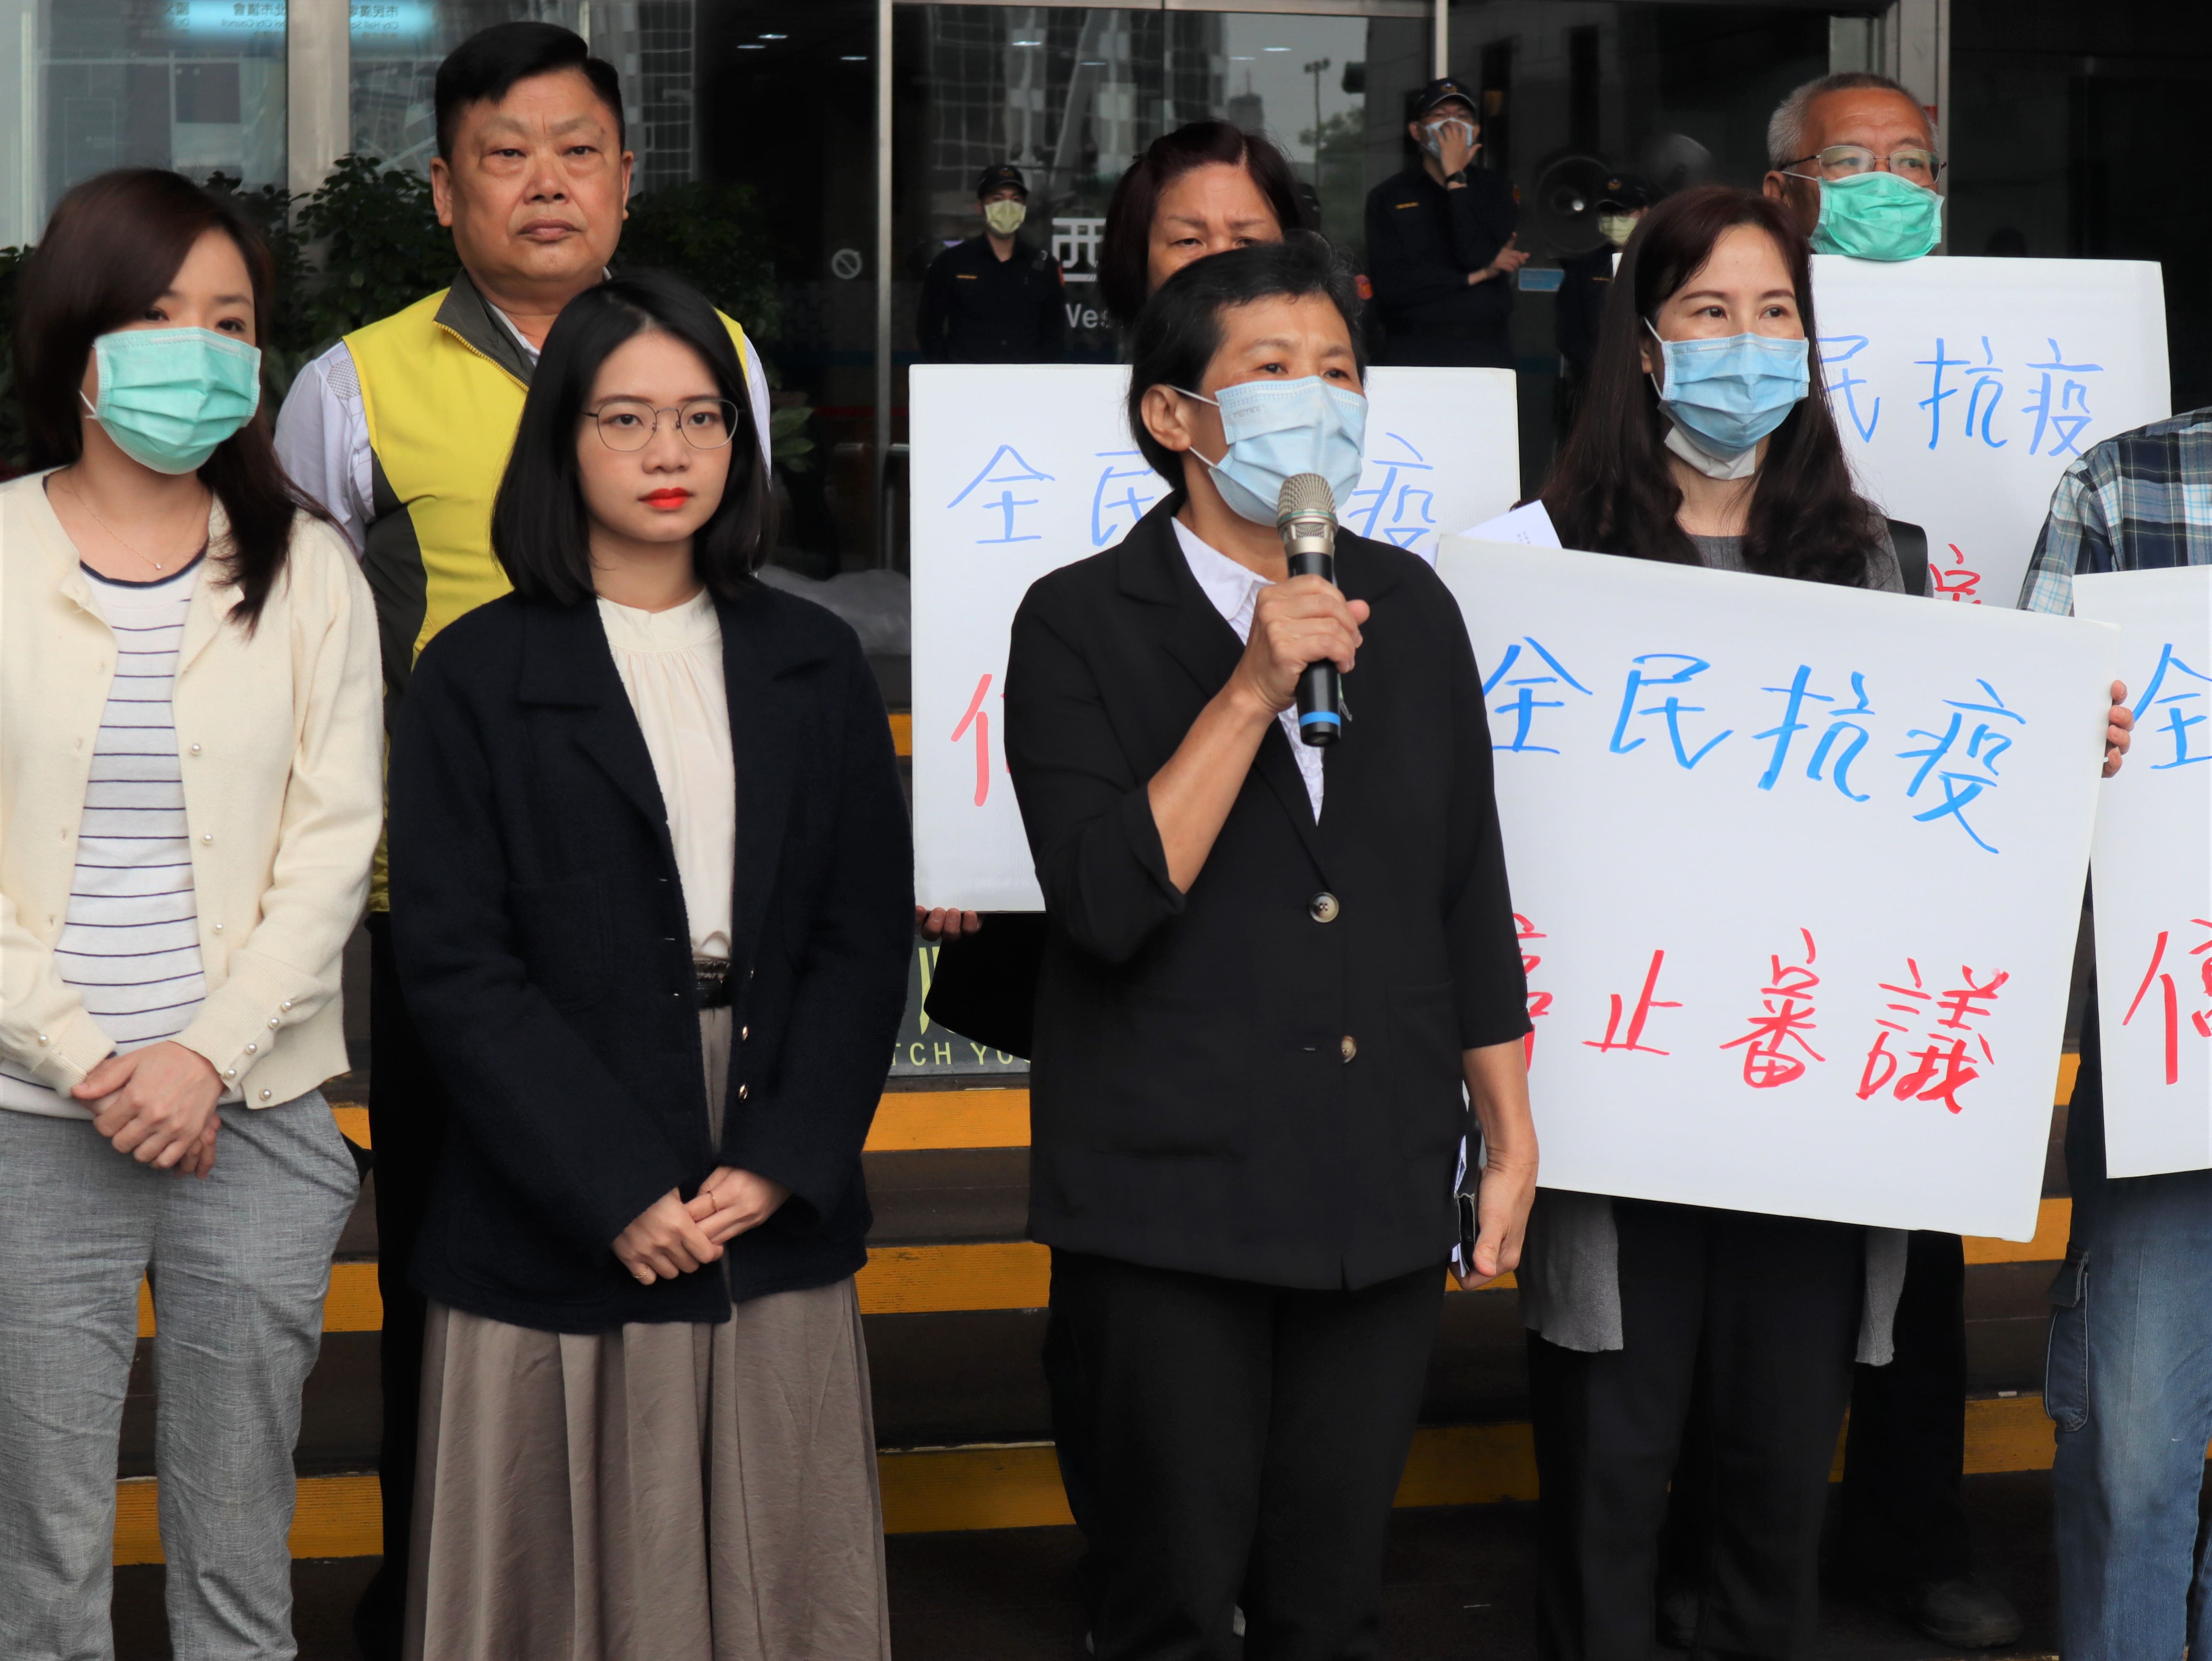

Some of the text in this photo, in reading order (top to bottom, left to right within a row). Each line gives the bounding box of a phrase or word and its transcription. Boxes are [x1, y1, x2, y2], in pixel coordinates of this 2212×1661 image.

[1482, 636, 2027, 855] 全民抗疫
[970, 1043, 1030, 1066] YO
